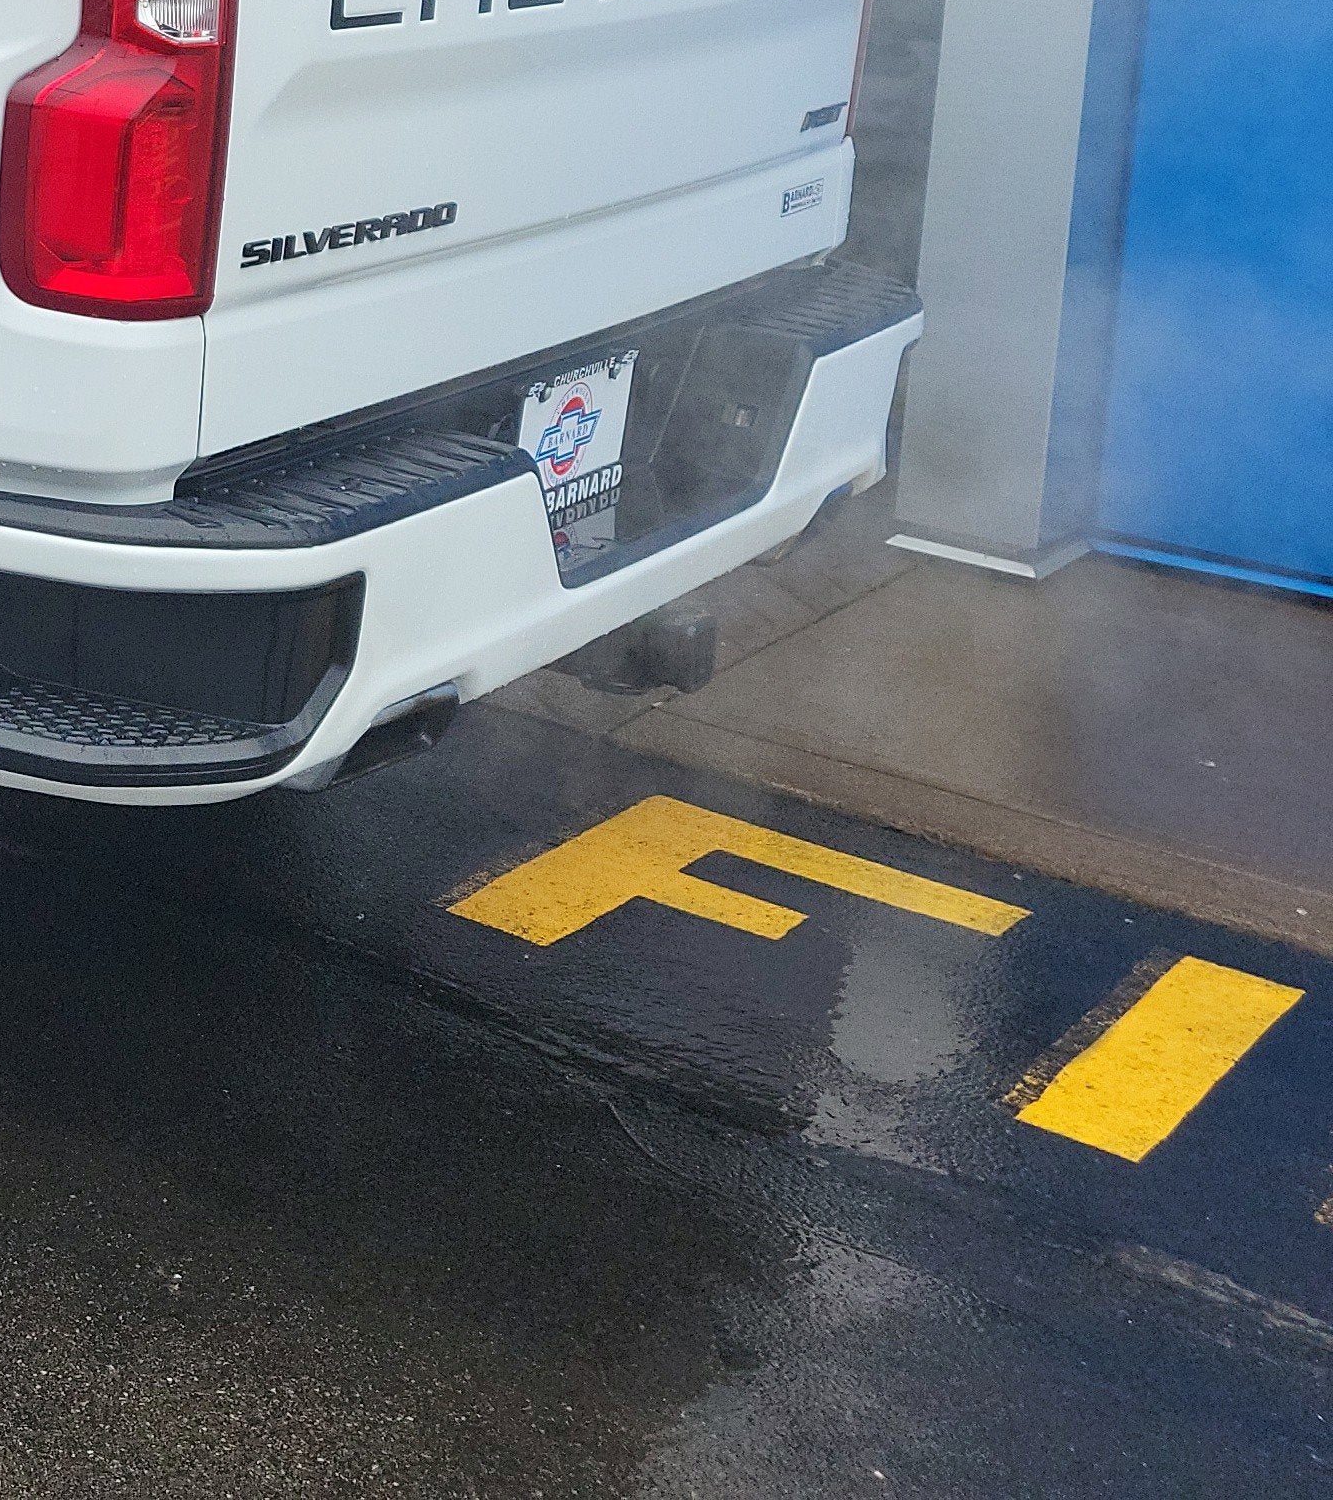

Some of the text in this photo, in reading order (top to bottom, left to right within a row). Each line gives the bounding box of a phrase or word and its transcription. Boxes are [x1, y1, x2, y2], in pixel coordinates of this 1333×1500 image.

[240, 201, 457, 268] SILVERADO
[554, 357, 616, 387] CHURCHVILLE
[546, 422, 590, 449] BARNARD
[545, 464, 623, 513] BARNARD
